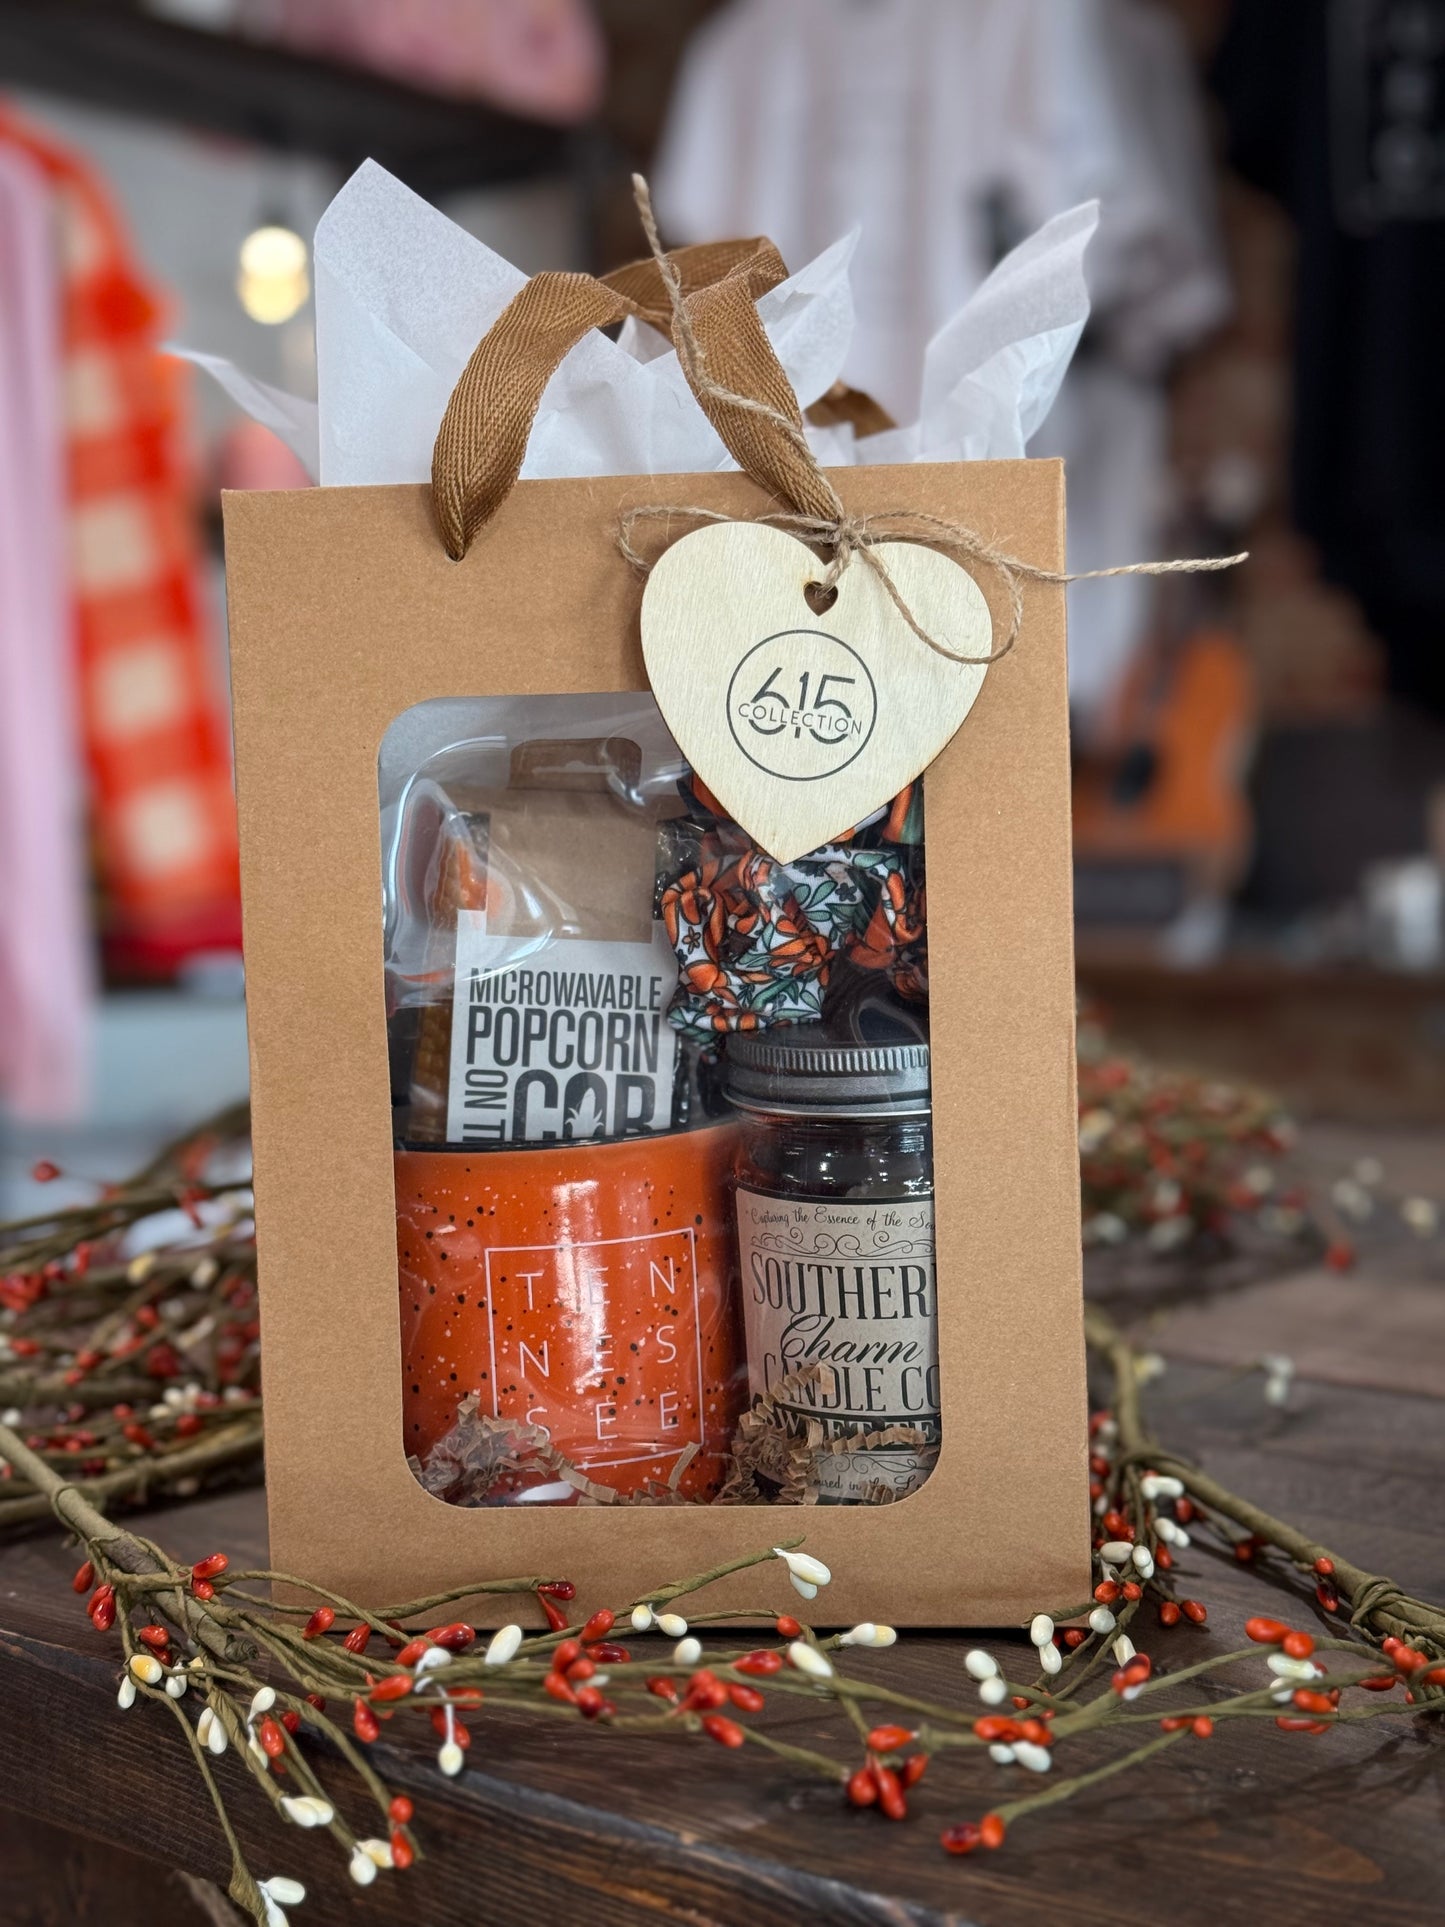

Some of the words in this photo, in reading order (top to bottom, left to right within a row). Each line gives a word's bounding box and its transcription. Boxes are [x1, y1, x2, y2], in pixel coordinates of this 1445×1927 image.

[738, 703, 862, 735] COLLECTION
[751, 667, 856, 744] 615
[469, 967, 663, 1012] MICROWAVABLE
[466, 1005, 660, 1073] POPCORN
[792, 1207, 809, 1225] the
[814, 1206, 859, 1225] Essence
[866, 1209, 877, 1231] of
[882, 1210, 903, 1227] the
[751, 1252, 938, 1320] SOUTHER
[780, 1314, 924, 1364] Charm
[848, 1482, 861, 1491] in
